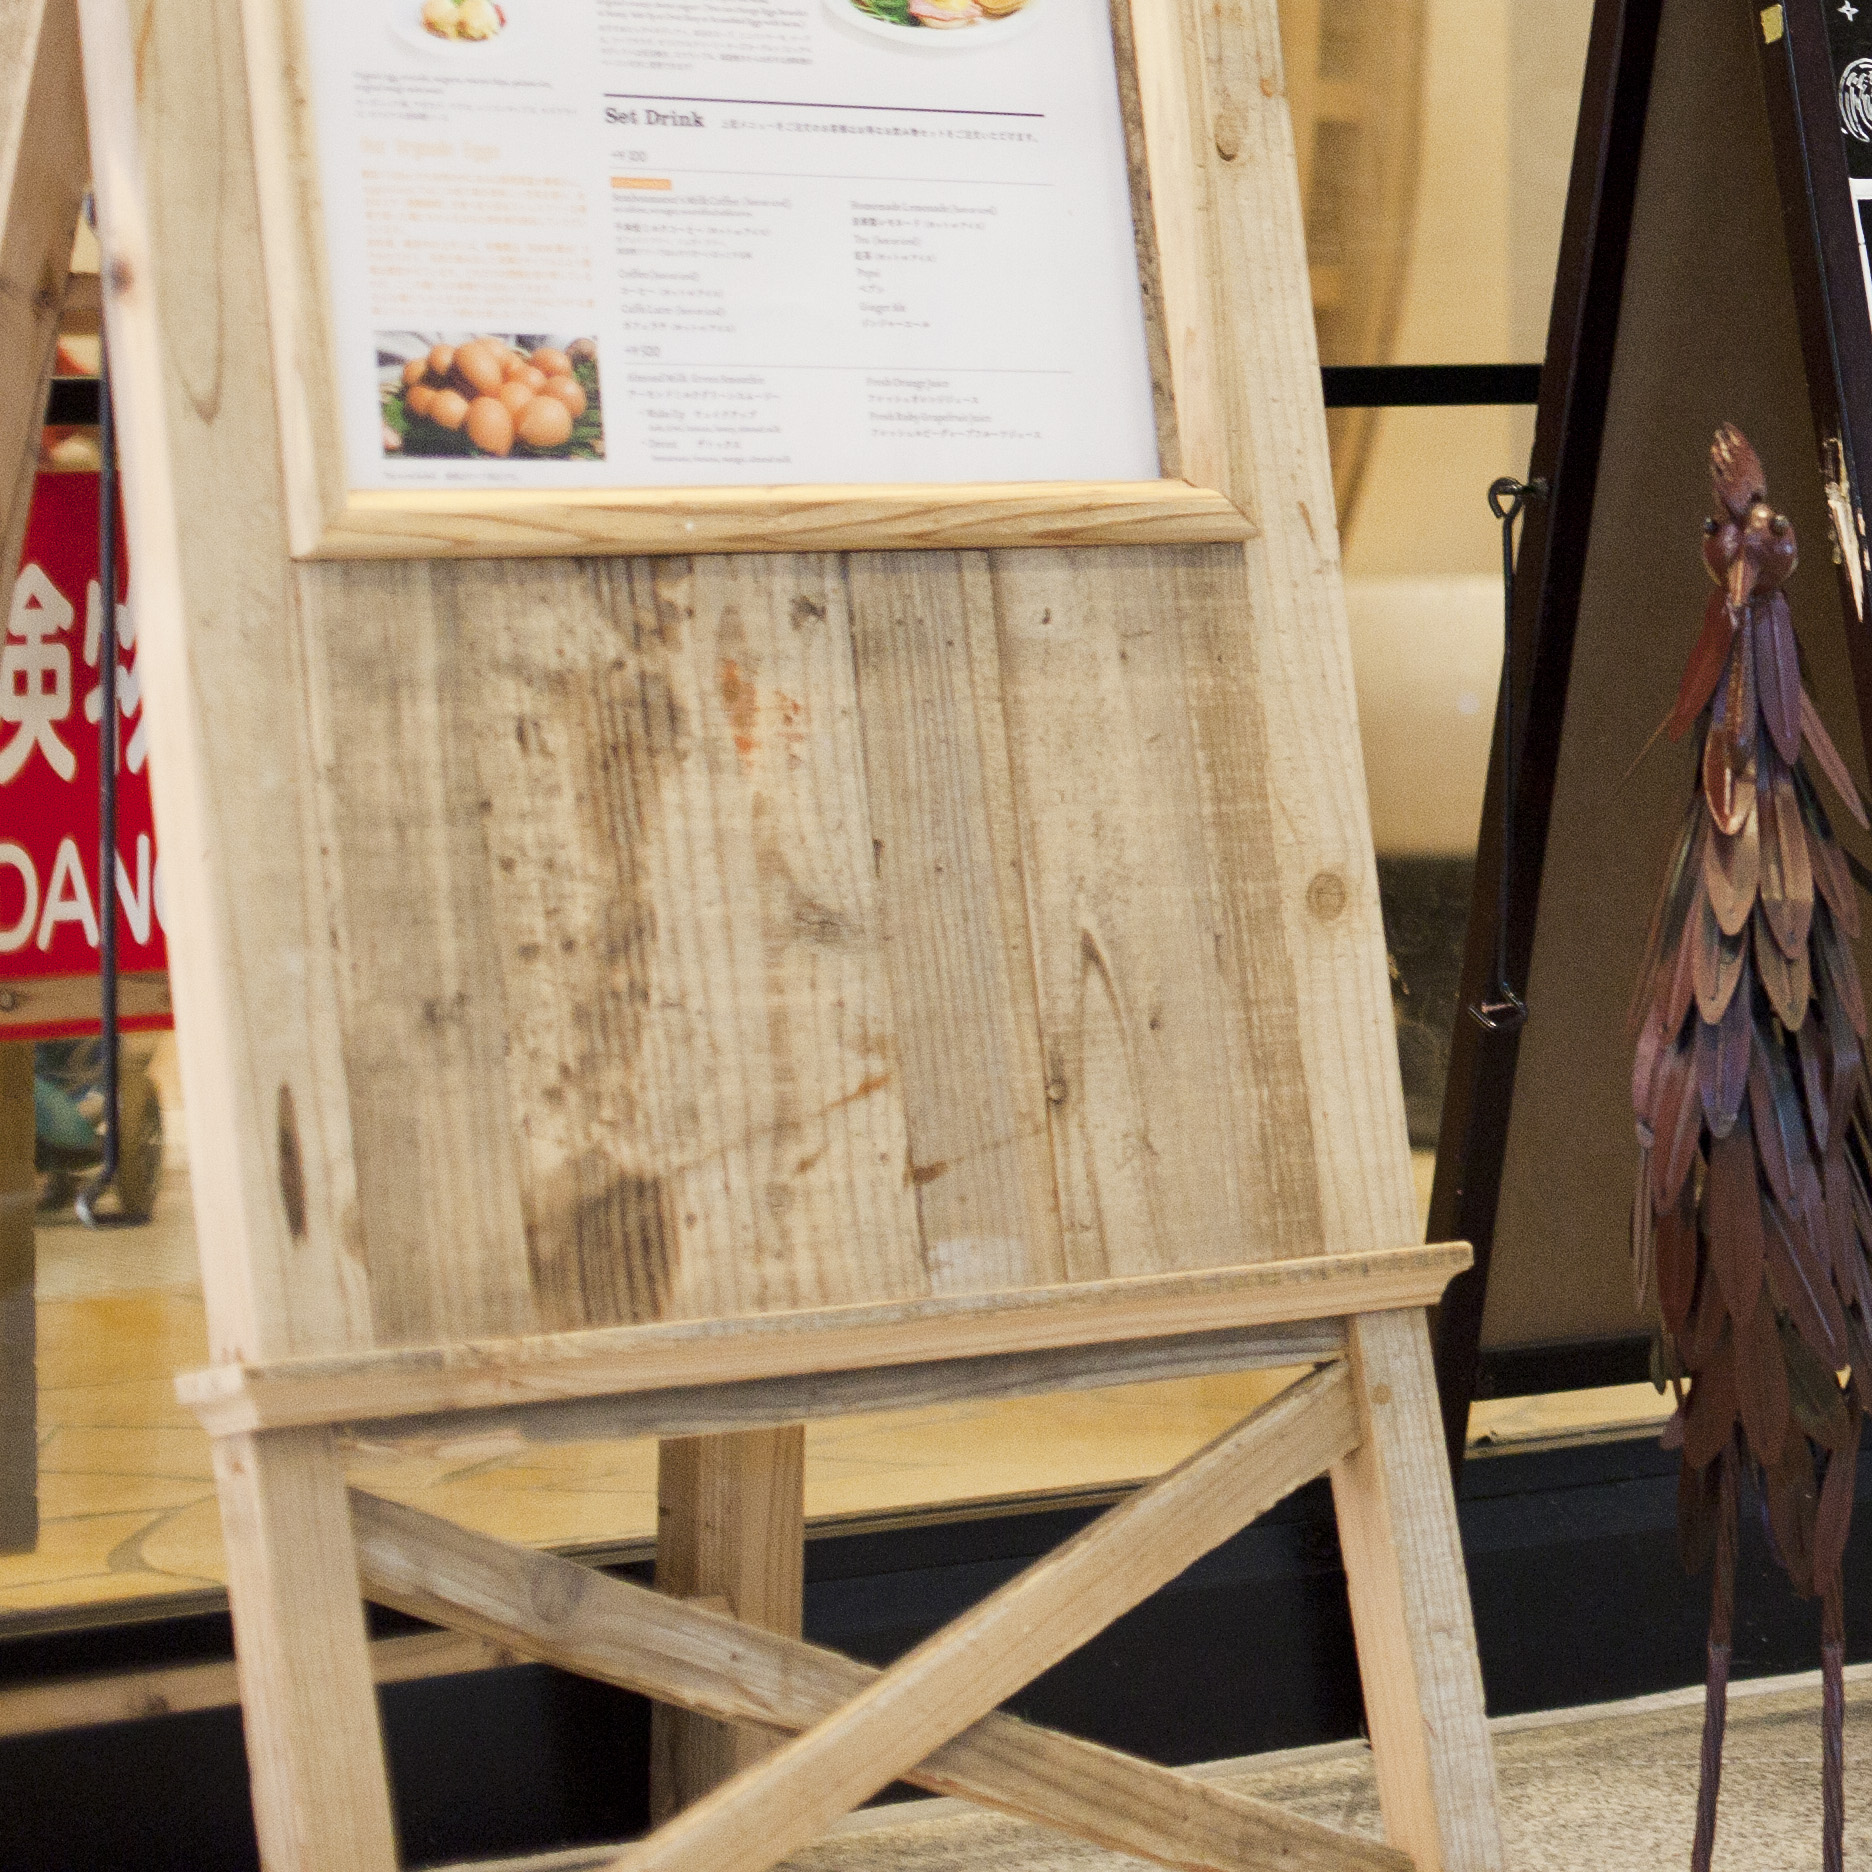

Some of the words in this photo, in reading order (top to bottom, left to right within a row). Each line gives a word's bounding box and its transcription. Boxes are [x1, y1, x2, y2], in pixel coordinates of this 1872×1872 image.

[605, 106, 638, 125] Set
[644, 108, 706, 129] Drink
[0, 830, 168, 954] DAN
